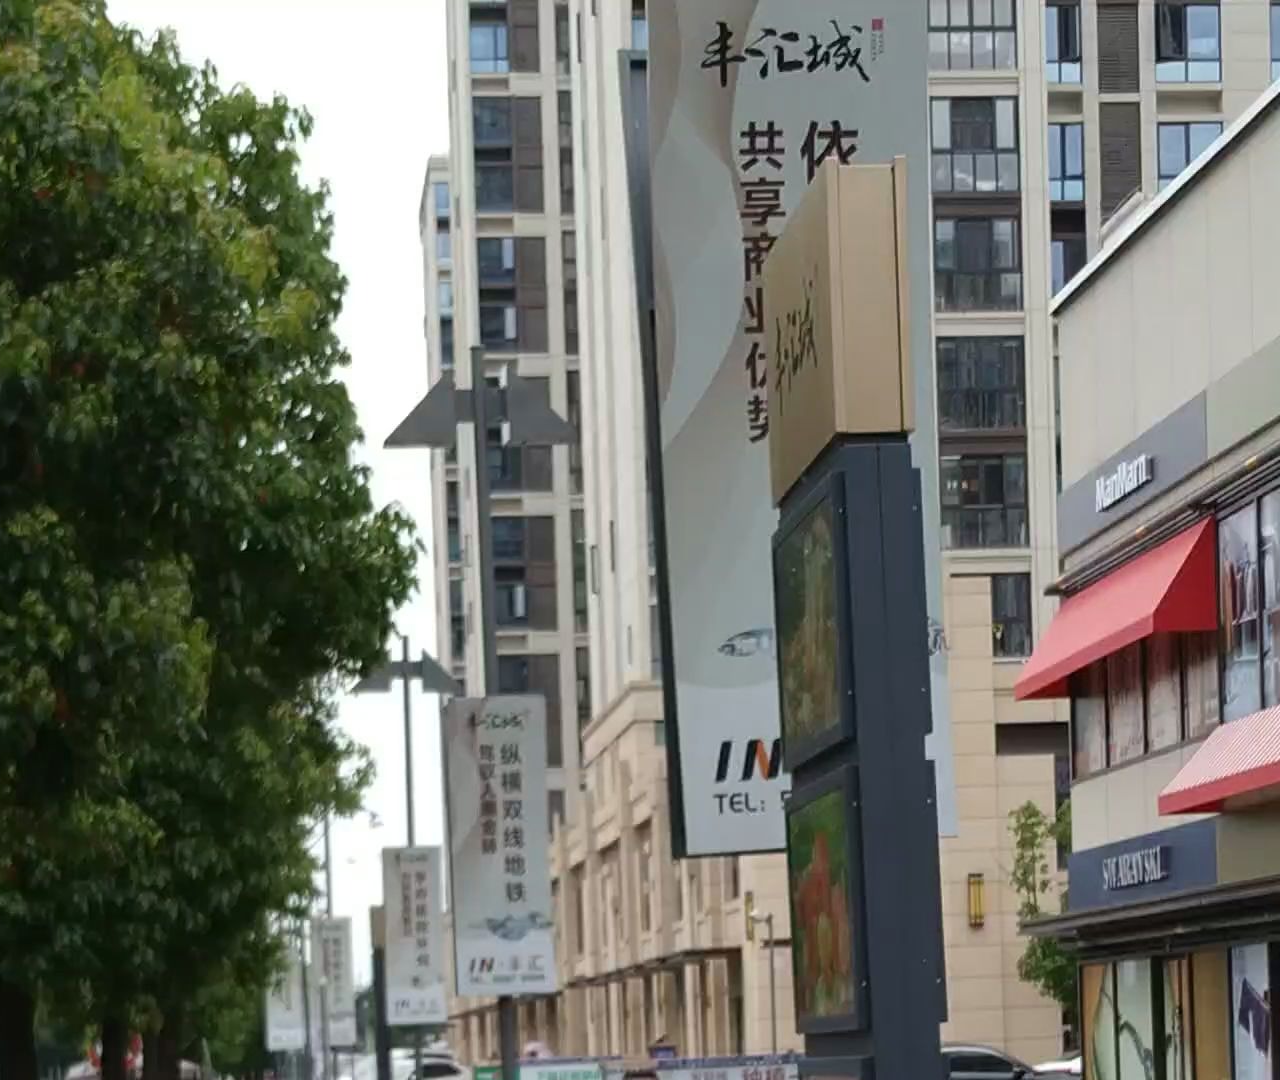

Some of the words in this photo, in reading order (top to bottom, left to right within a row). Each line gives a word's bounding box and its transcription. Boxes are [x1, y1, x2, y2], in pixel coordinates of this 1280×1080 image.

[701, 19, 870, 87] 丰汇城
[500, 743, 527, 904] 纵横双线地铁
